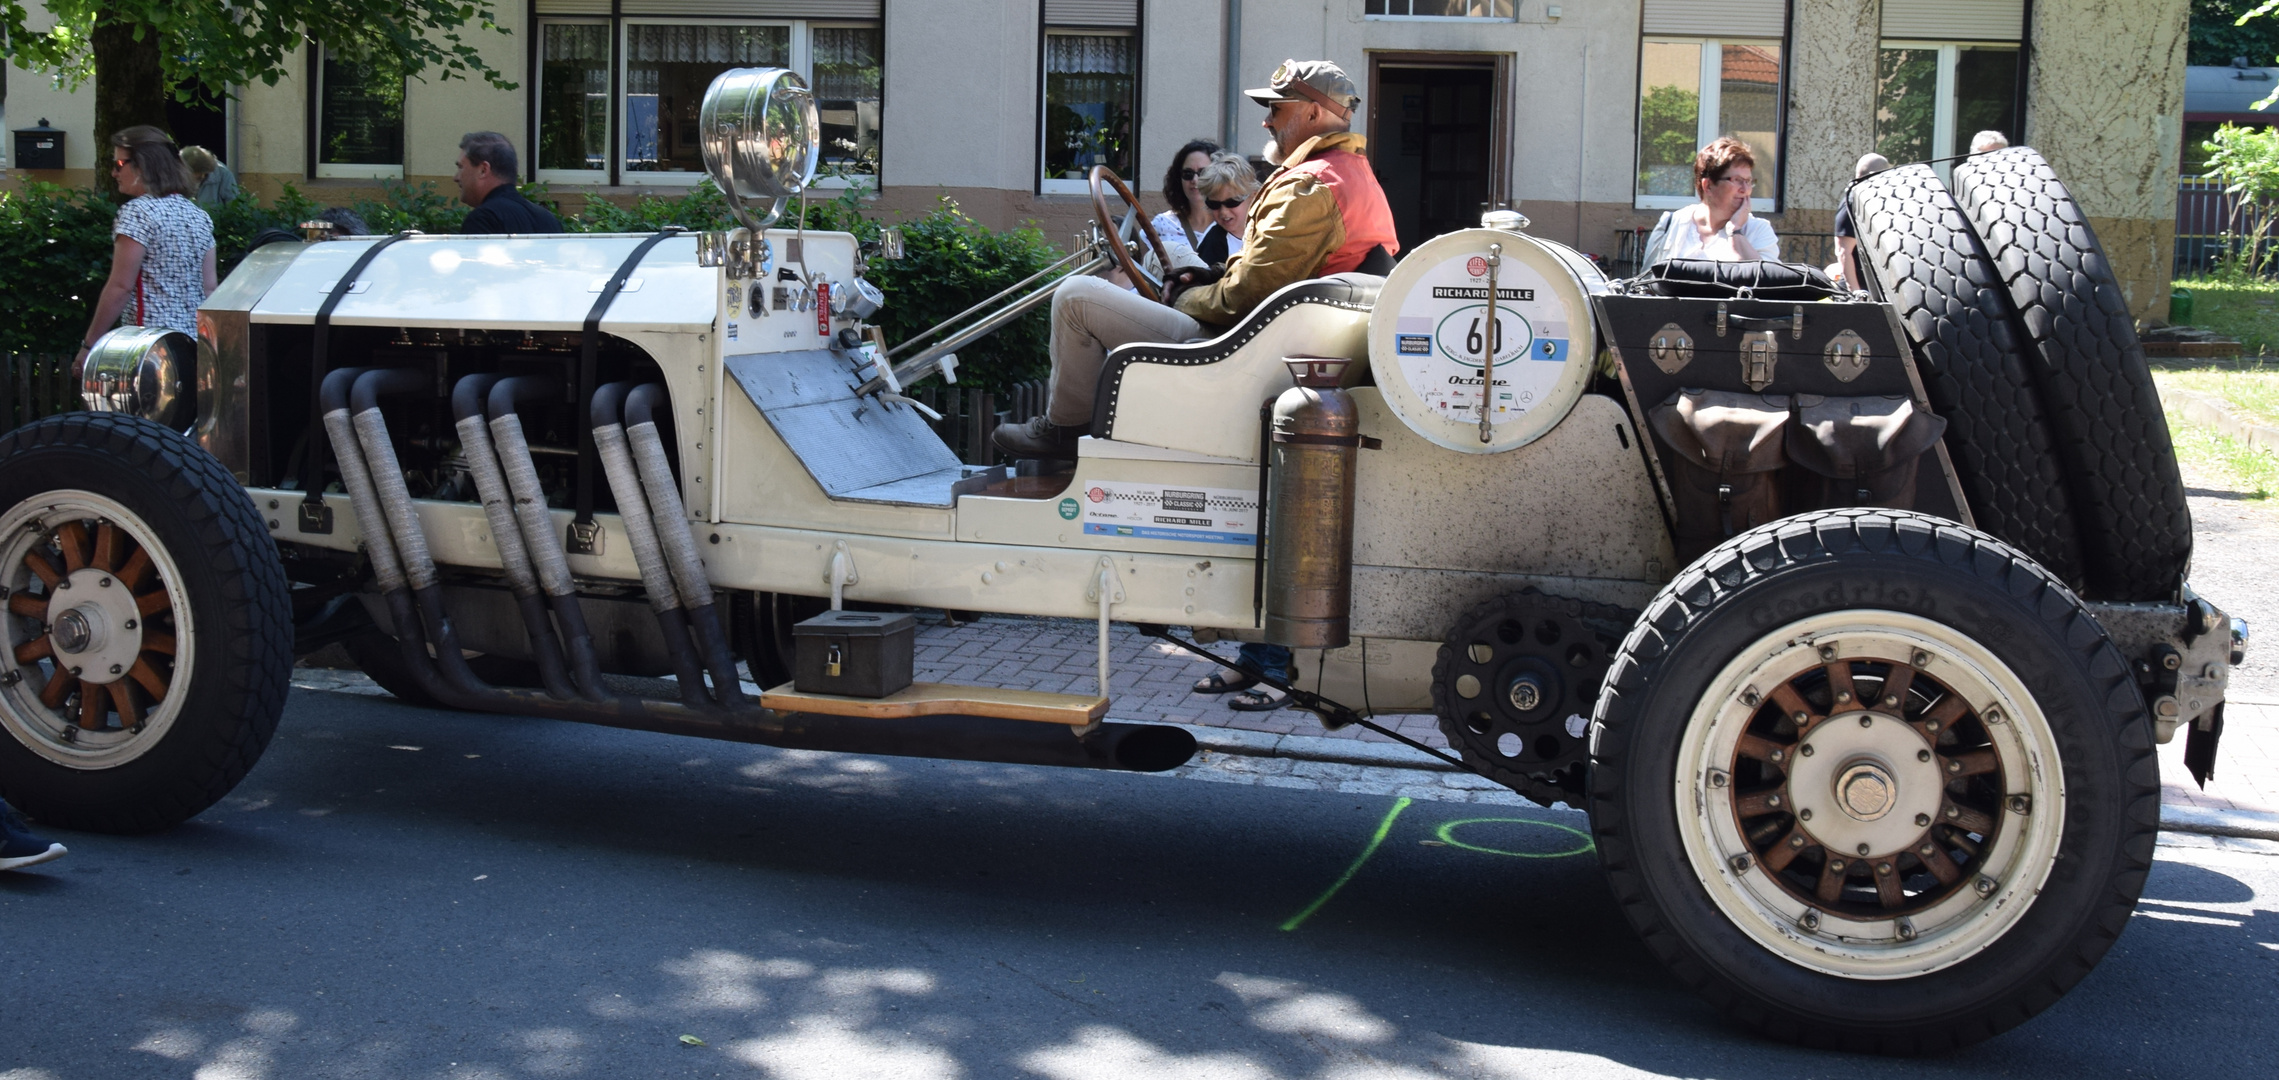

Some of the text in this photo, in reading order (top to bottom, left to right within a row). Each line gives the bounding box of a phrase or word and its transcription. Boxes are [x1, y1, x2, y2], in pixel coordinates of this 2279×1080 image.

[1435, 288, 1532, 299] RICHARD MILLE
[1466, 317, 1502, 355] 60
[1155, 516, 1186, 524] RICHARD
[1746, 578, 1938, 629] Goodrich
